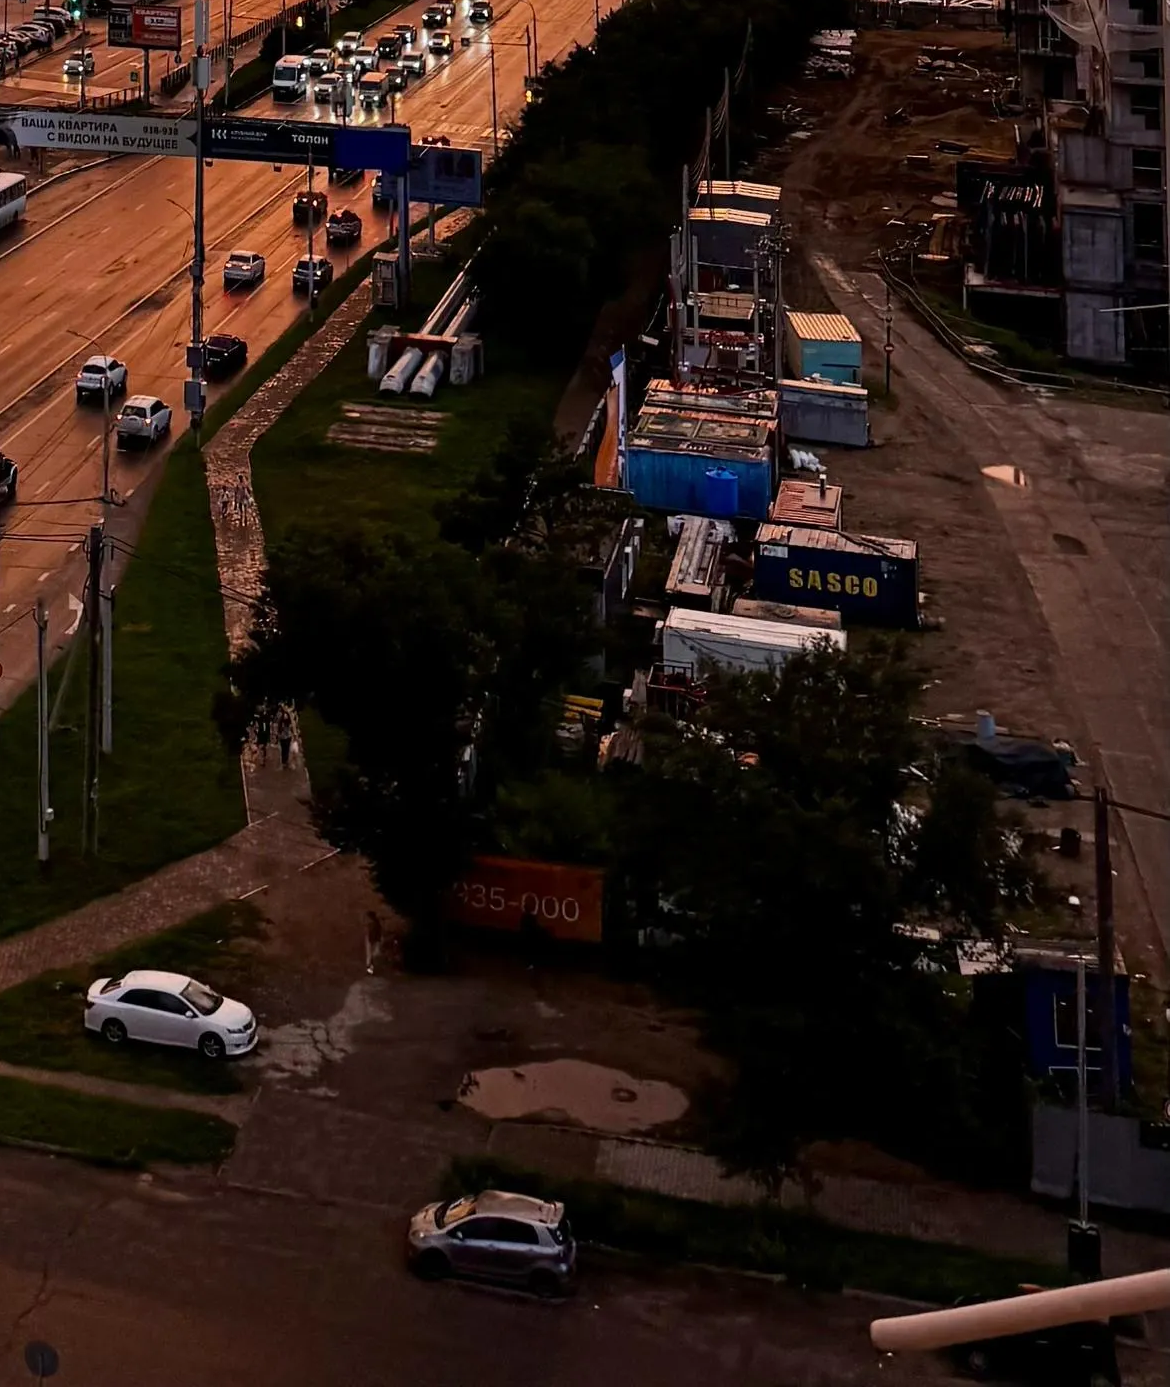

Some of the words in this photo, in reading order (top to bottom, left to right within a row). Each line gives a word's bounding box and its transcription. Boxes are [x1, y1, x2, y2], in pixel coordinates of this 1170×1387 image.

[21, 117, 56, 129] ВАША
[58, 120, 118, 133] КВАРТИРА
[47, 132, 56, 141] С
[58, 134, 101, 145] ВИДОМ
[103, 136, 120, 146] НА
[122, 136, 179, 150] БУДУЩЕЕ
[291, 133, 329, 145] талан
[788, 567, 878, 597] SASCO
